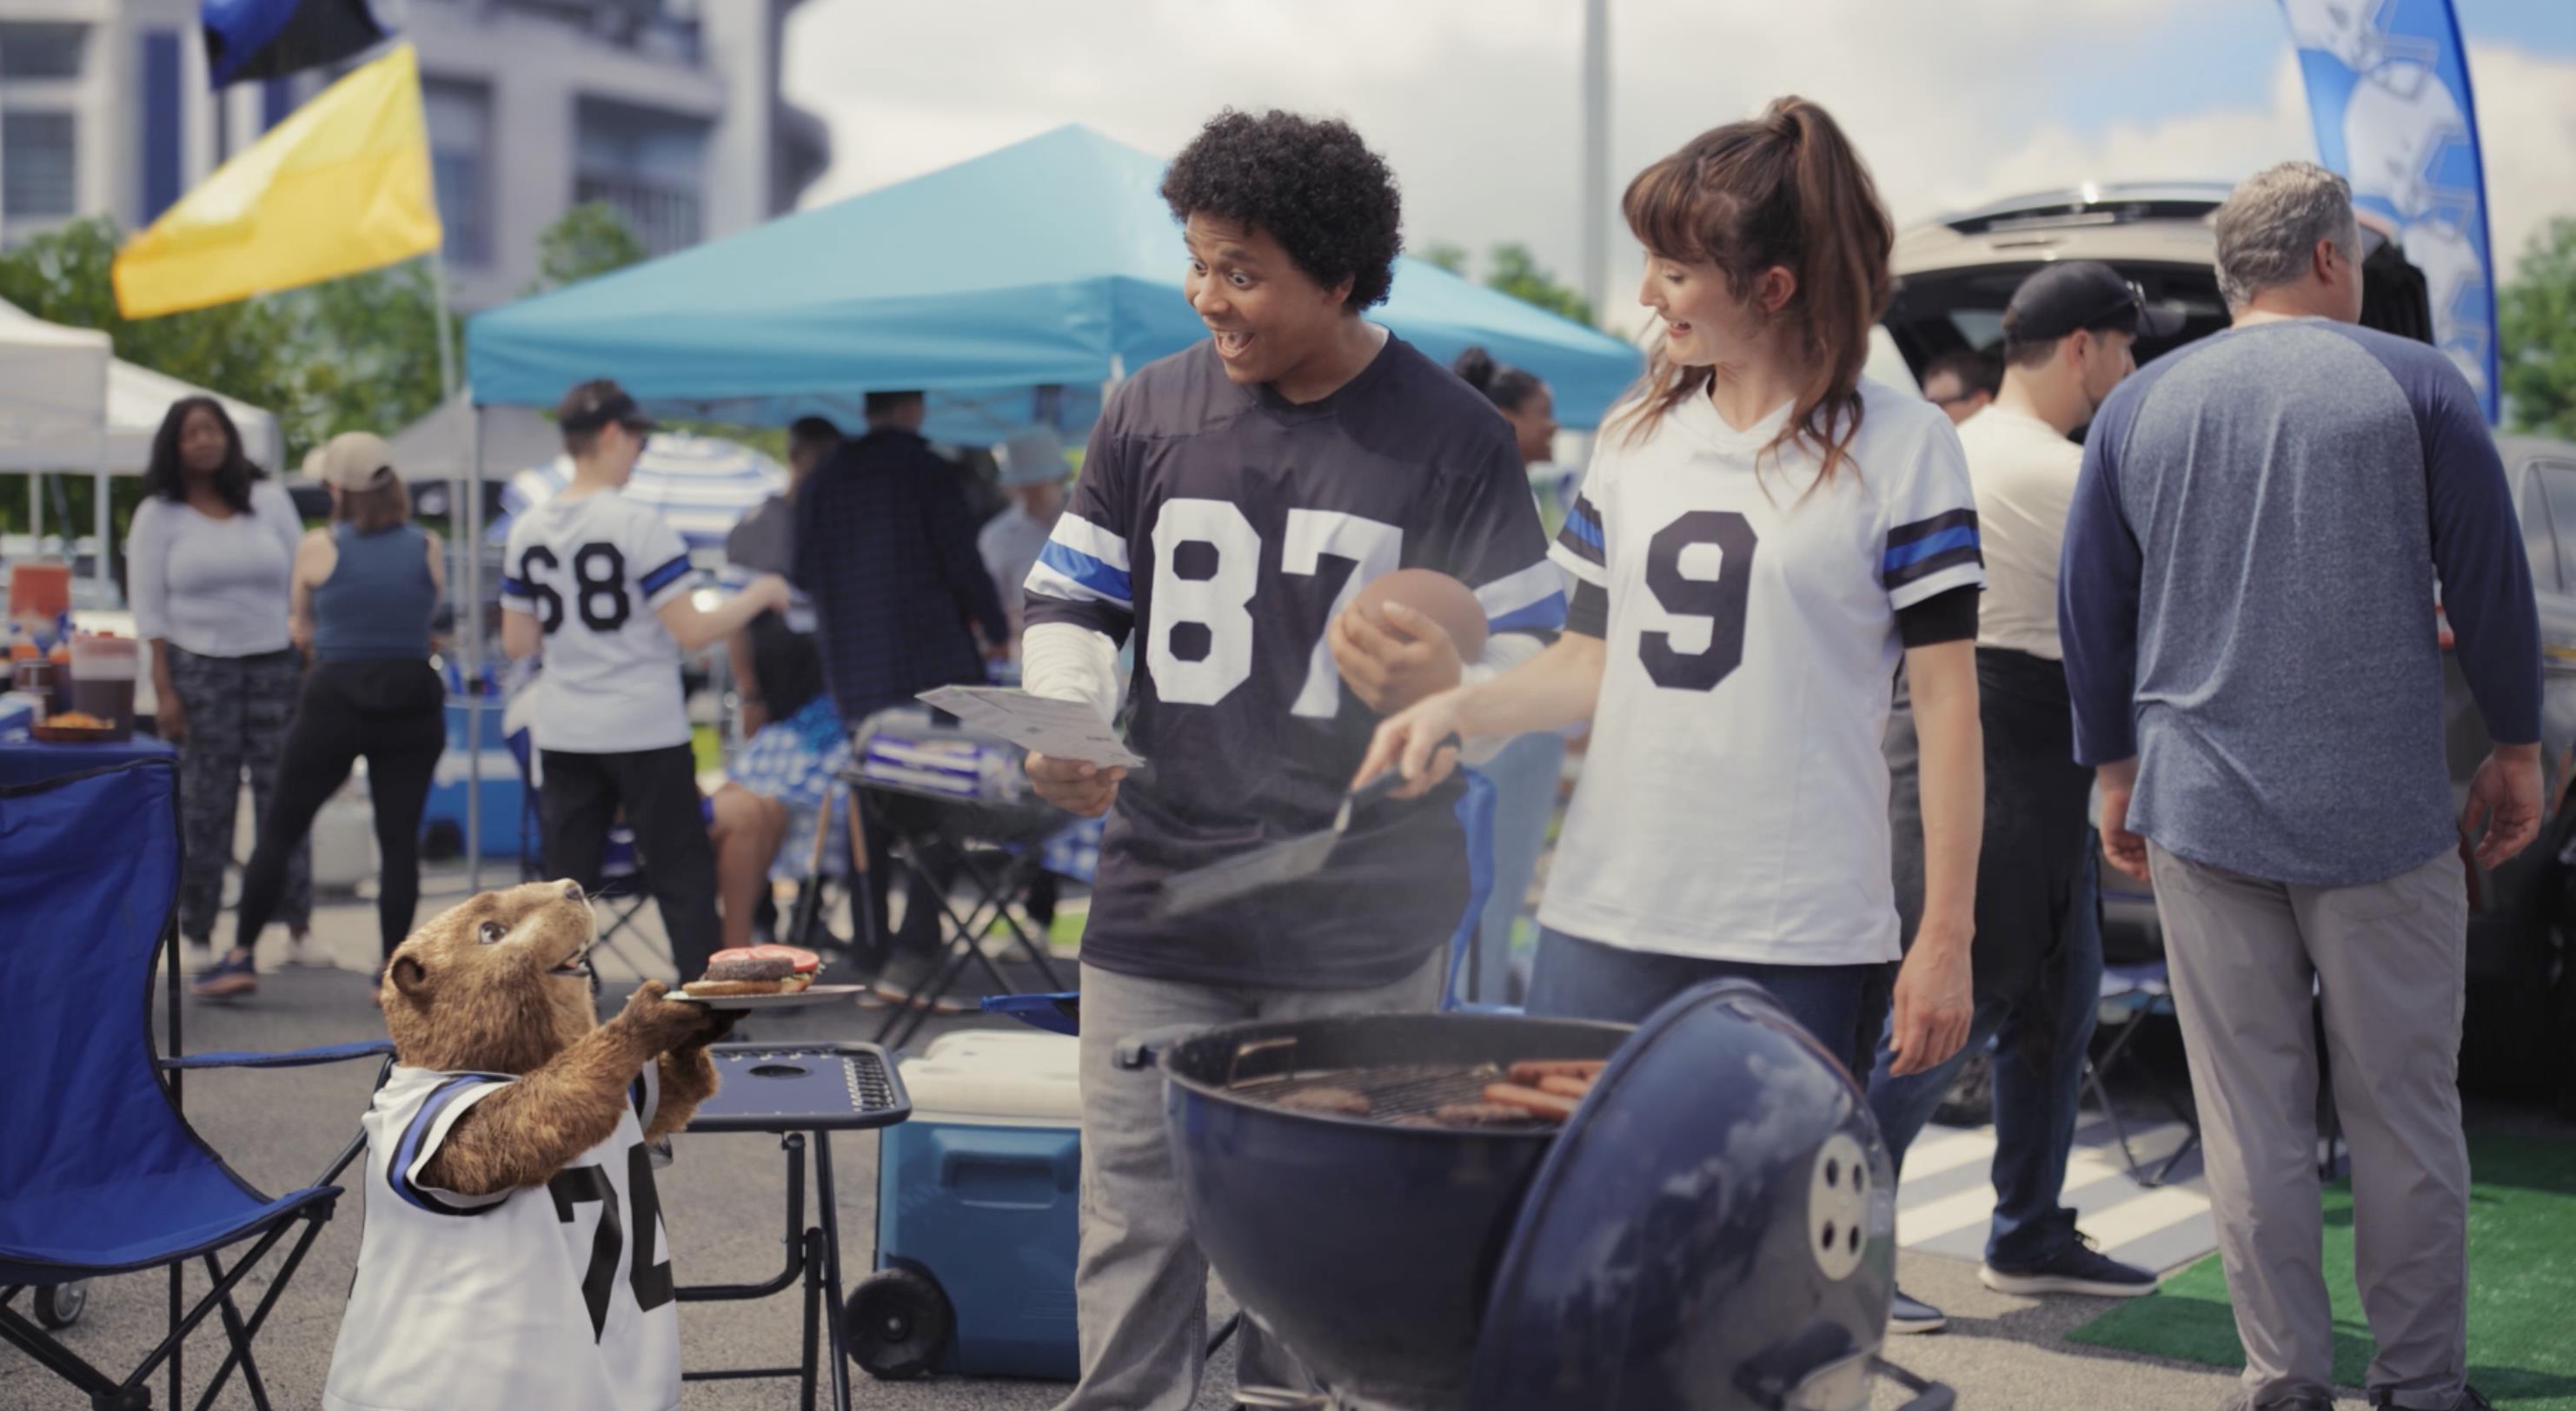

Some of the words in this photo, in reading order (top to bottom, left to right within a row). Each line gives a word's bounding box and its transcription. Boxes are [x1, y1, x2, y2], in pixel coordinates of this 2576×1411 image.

[521, 542, 630, 634] 68
[1146, 498, 1404, 719] 87
[1638, 510, 1758, 692] 9
